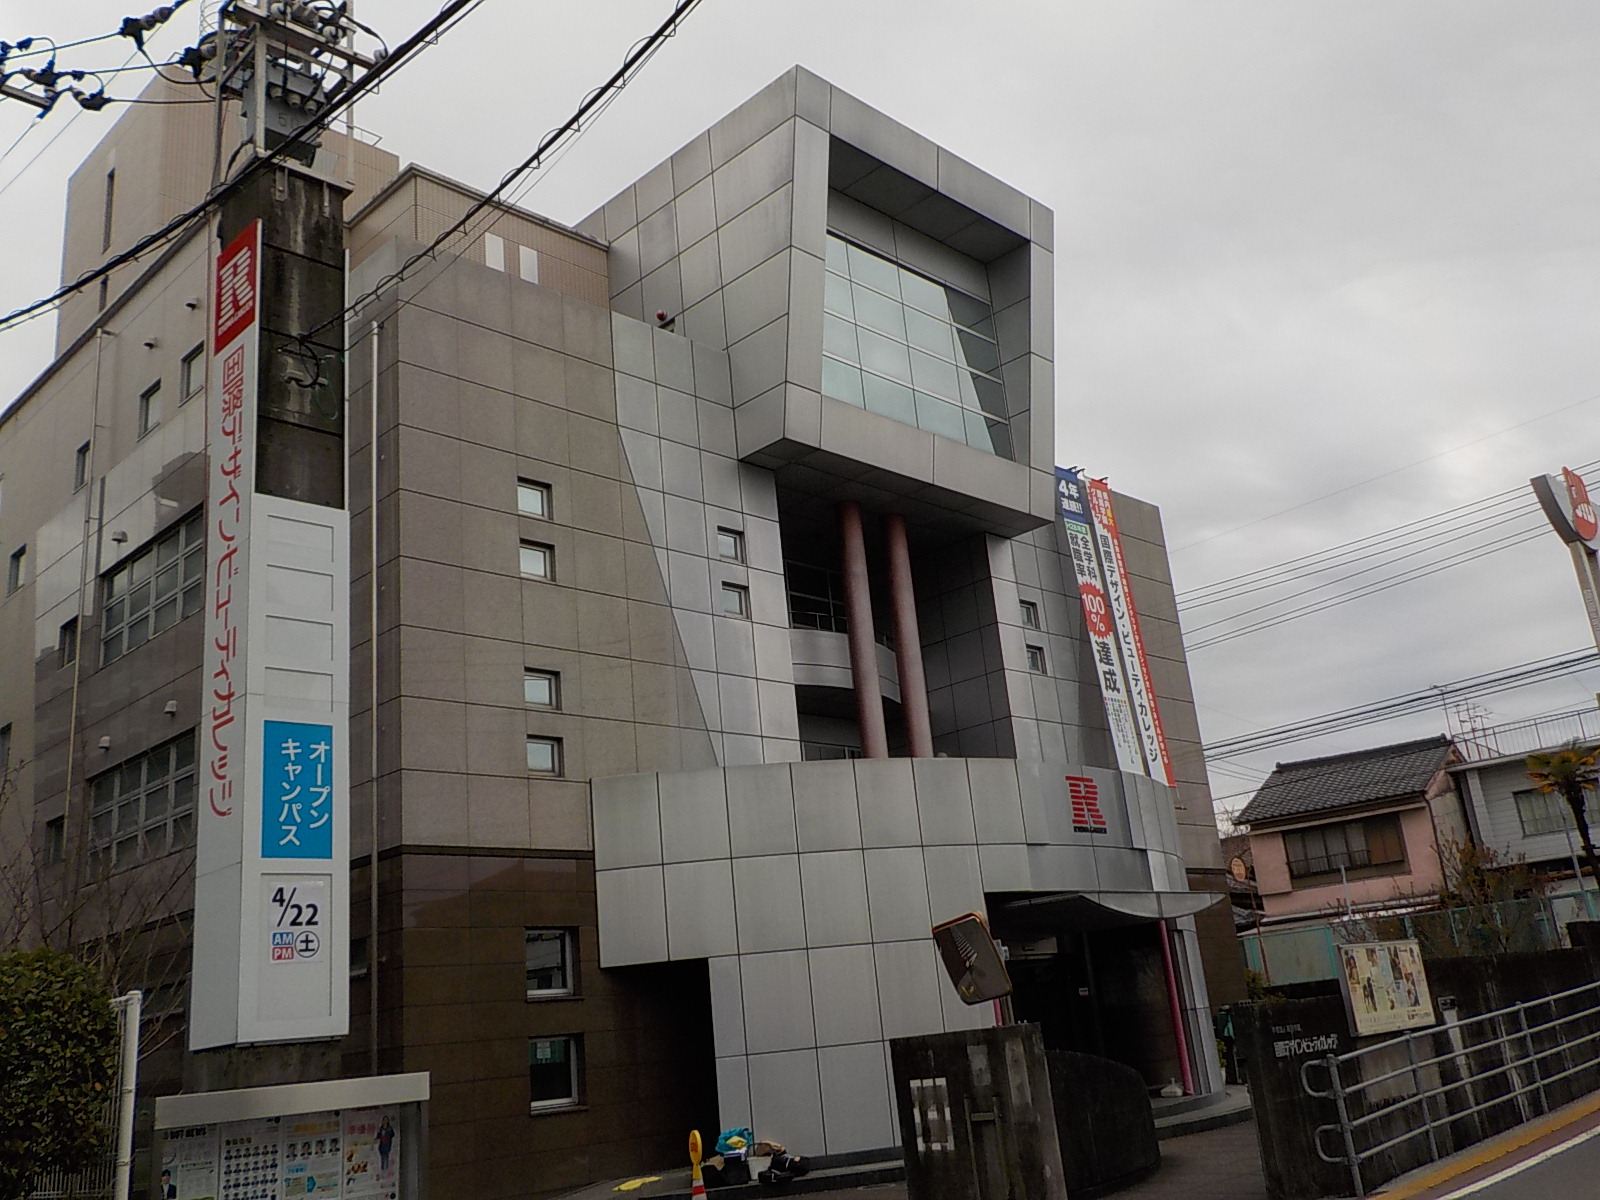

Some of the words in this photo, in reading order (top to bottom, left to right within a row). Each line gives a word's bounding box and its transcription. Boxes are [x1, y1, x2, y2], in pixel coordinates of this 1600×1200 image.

[1058, 480, 1080, 499] 4年
[1080, 536, 1098, 582] 全学科
[1082, 593, 1105, 615] 100
[1094, 640, 1121, 695] 達成
[279, 738, 303, 847] キャンパス
[308, 741, 331, 829] オープン
[271, 886, 320, 928] 4/22
[272, 932, 294, 946] AM
[272, 946, 294, 961] PM
